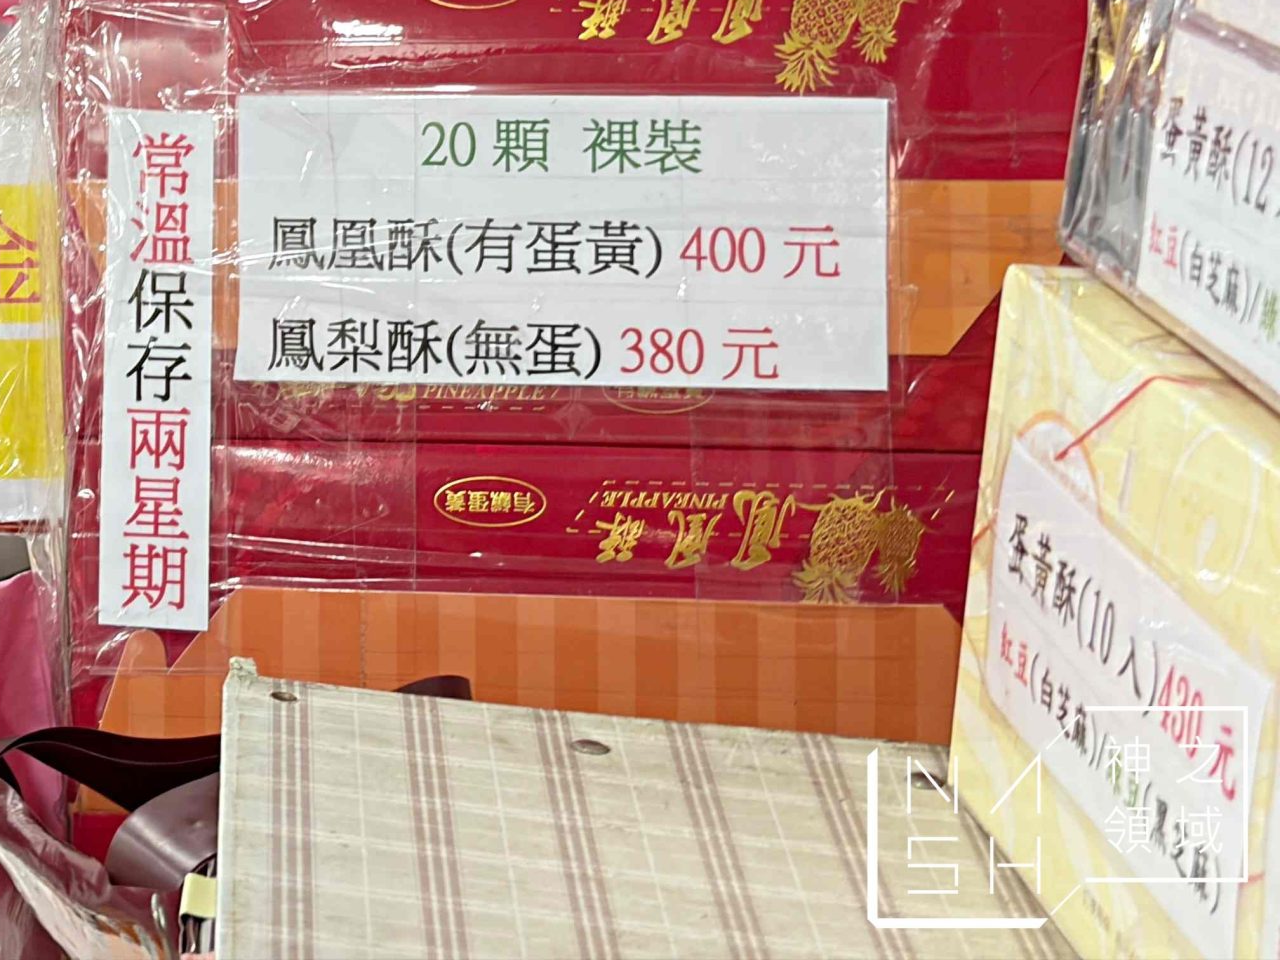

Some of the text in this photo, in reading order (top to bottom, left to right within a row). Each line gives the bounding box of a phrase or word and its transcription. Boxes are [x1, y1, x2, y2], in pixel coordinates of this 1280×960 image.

[420, 119, 702, 173] 20 顆 裸裝
[1160, 96, 1280, 217] 蛋黃酥(12
[267, 217, 841, 280] 鳳凰酥(有蛋黃) 400 元
[120, 133, 197, 610] 常溫保存兩星期
[266, 317, 779, 380] 鳳梨酥(無蛋) 380 元
[422, 384, 545, 400] PINEAPPLE
[602, 491, 727, 510] PINEAPPLE
